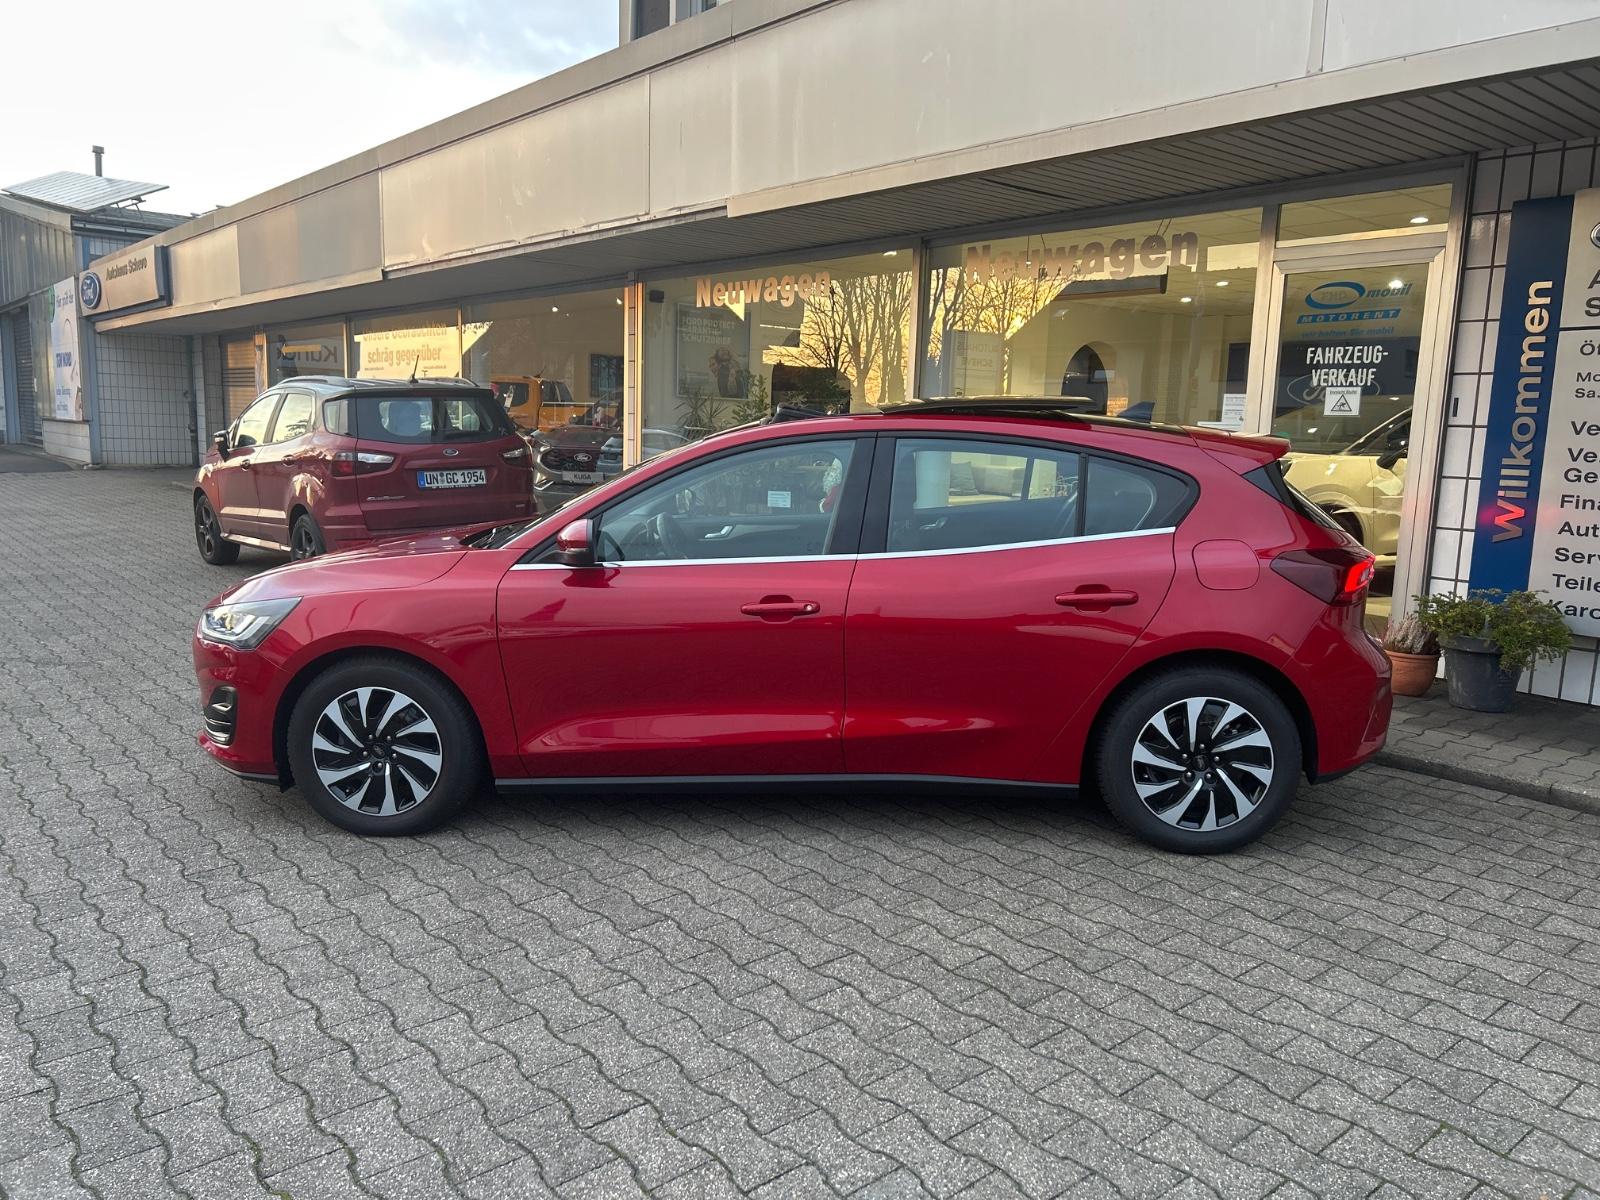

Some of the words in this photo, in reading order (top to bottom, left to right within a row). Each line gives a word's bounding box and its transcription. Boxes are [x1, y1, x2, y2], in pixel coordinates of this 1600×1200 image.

[966, 231, 1198, 283] Neuwagen
[106, 264, 128, 281] Autohaus
[696, 271, 831, 308] Neuwagen
[1366, 284, 1412, 298] mobil
[1301, 310, 1397, 323] MOTORENT
[367, 346, 394, 367] schräg
[396, 344, 442, 366] gegenüber
[1306, 345, 1389, 365] FAHRZEUG-
[1312, 368, 1377, 387] VERKAUF
[1492, 280, 1553, 543] Willkommen
[425, 472, 440, 485] UN
[445, 472, 459, 484] GC
[460, 471, 485, 484] 1954
